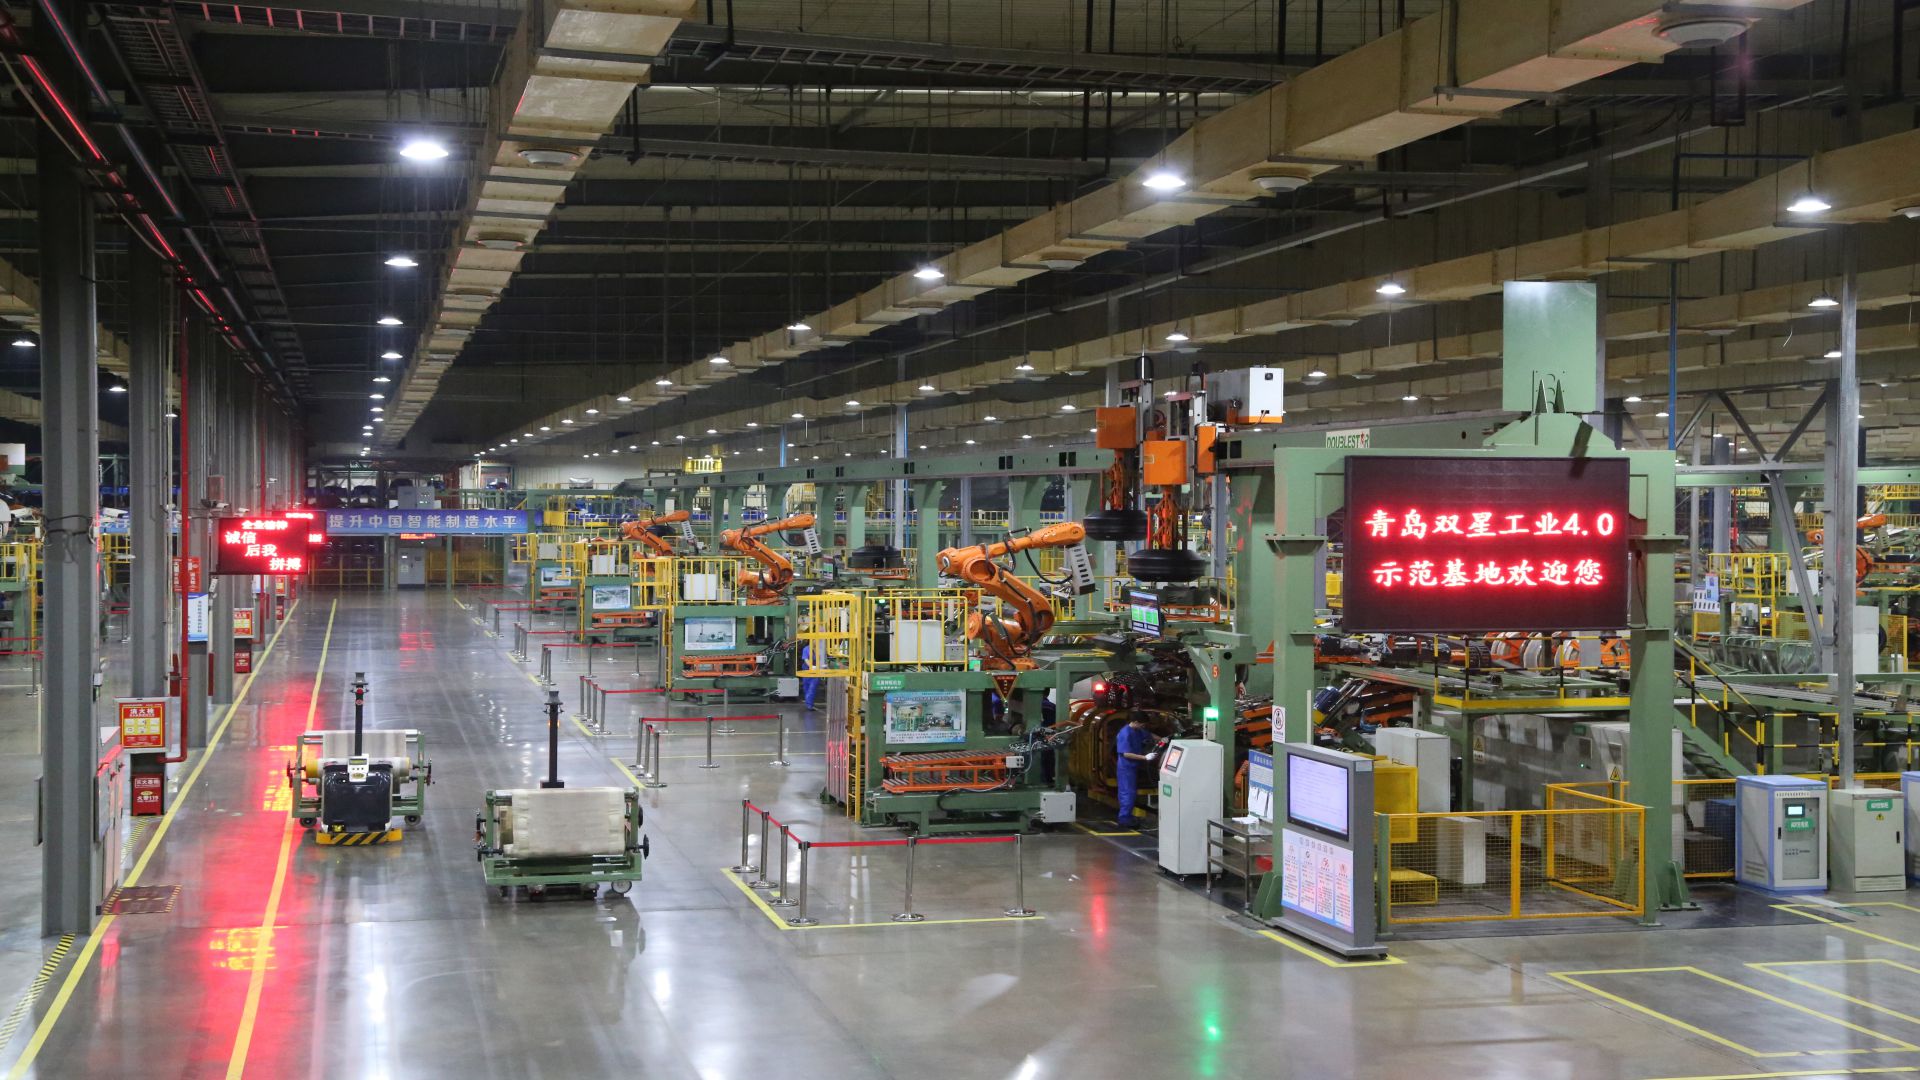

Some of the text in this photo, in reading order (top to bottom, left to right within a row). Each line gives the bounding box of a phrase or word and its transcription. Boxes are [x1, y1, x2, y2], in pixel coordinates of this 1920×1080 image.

[328, 513, 518, 529] 提升中国智能制造水平
[1364, 509, 1614, 540] 青岛双星工业4.0
[224, 530, 257, 544] 诚信
[244, 544, 278, 557] 后我
[1372, 558, 1604, 587] 示范基地欢迎您
